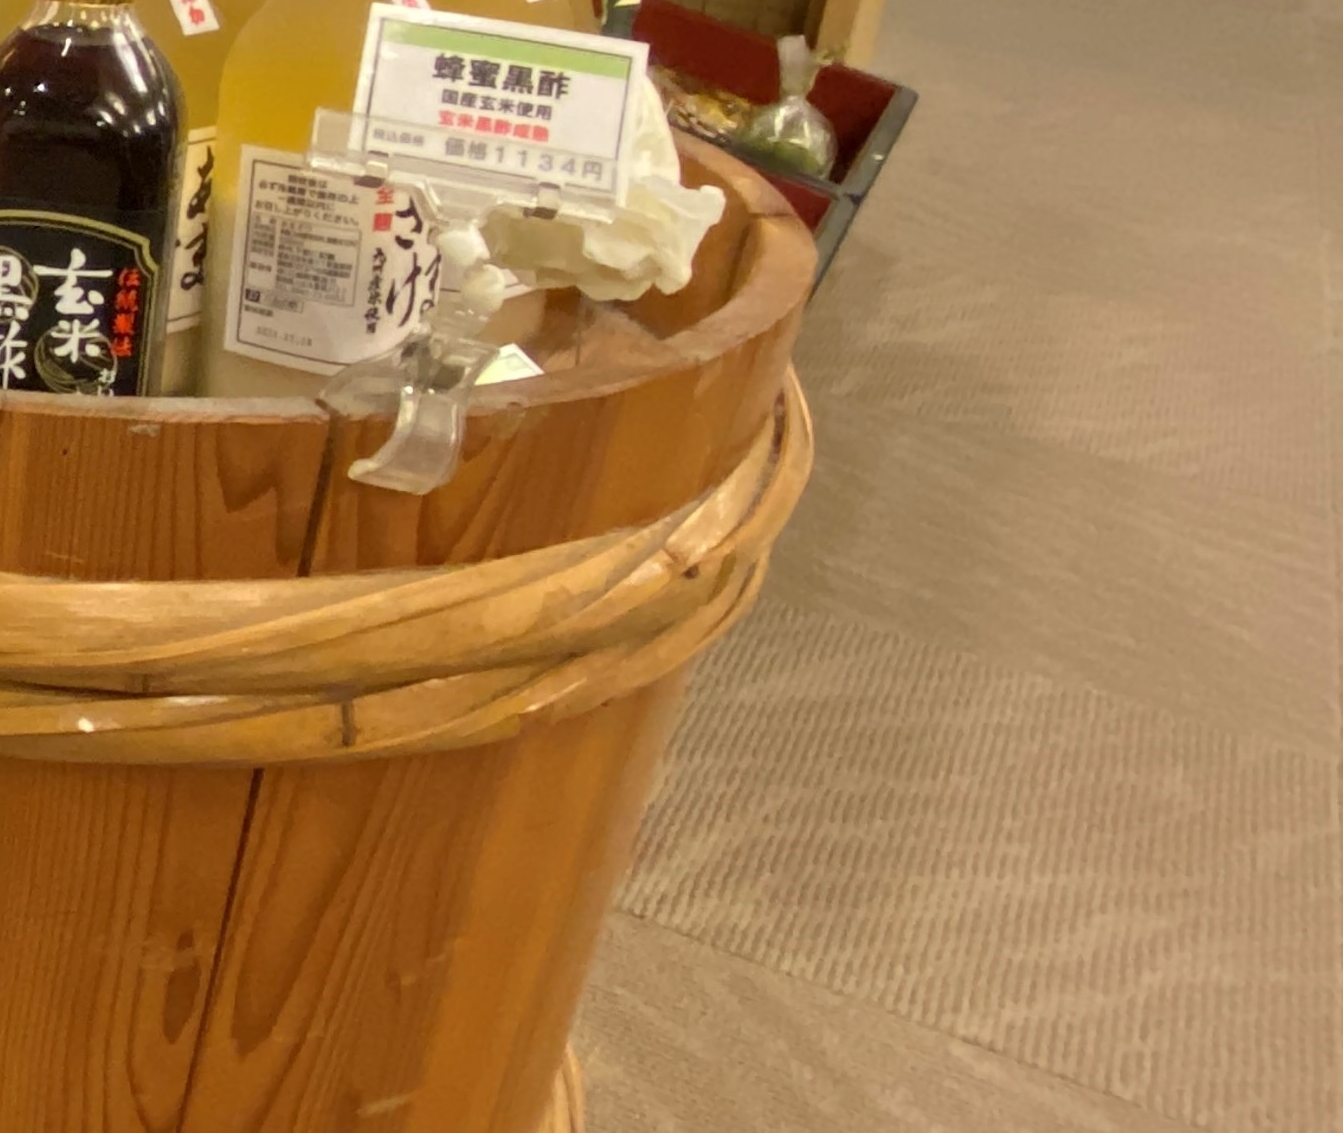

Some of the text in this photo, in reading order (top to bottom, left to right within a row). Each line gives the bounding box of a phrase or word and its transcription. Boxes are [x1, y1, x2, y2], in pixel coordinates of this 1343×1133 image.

[432, 53, 572, 100] 蜂蜜黒酢
[441, 89, 554, 121] 国産玄米使用
[33, 247, 114, 364] 玄米
